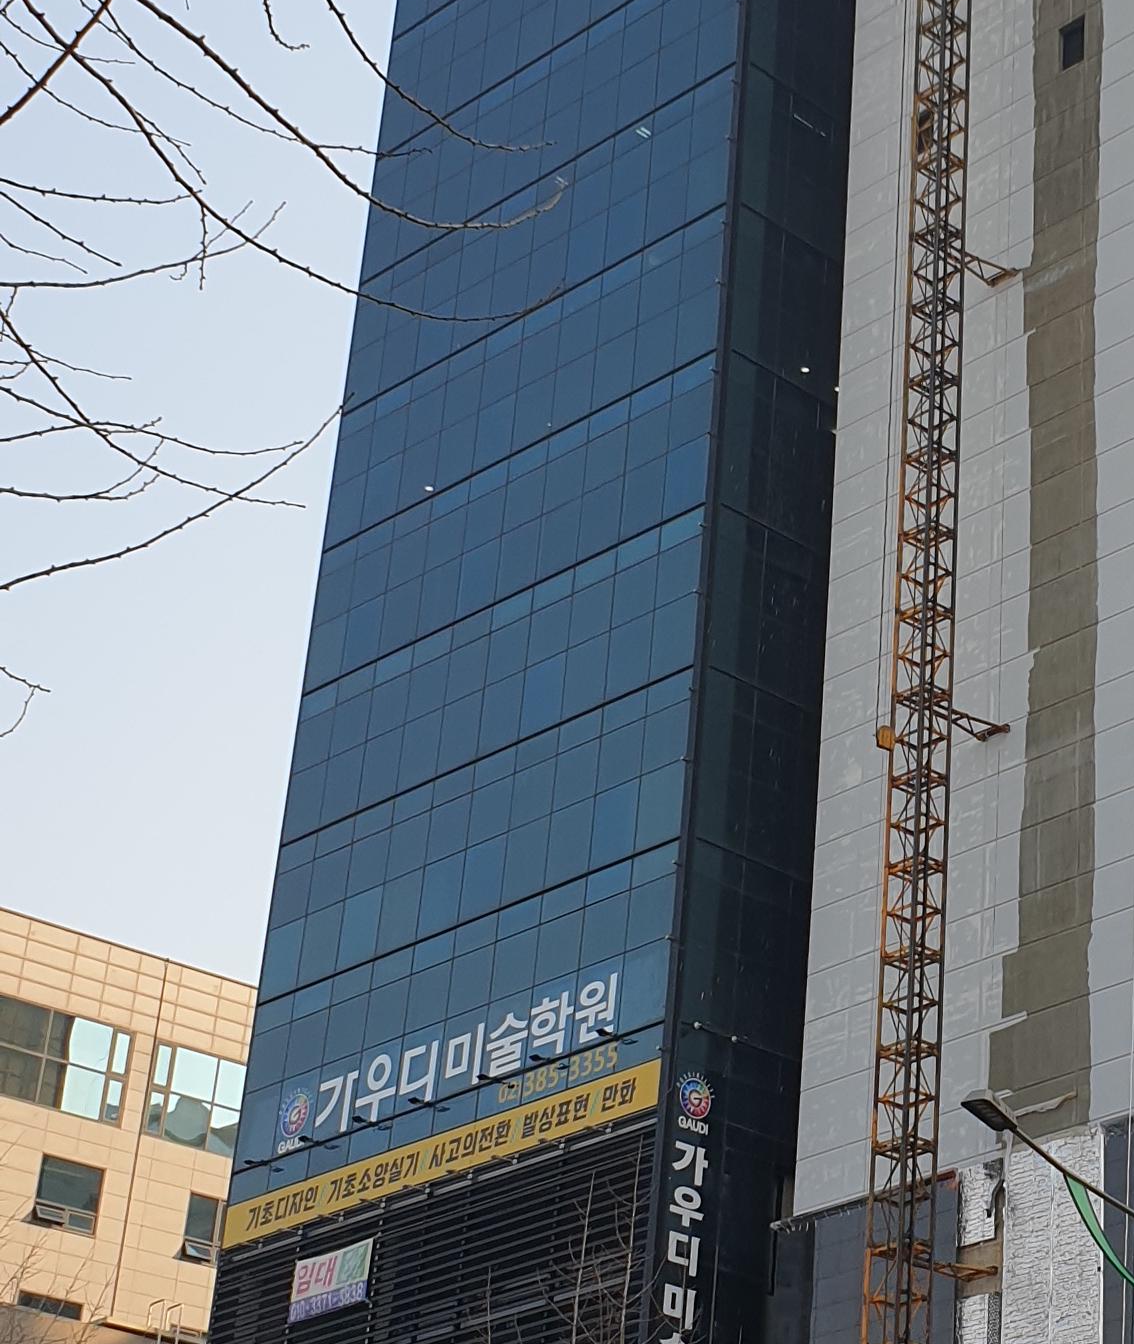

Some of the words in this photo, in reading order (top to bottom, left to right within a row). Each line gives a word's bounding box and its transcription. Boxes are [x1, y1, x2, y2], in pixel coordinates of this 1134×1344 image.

[315, 972, 618, 1133] 가우디미술학원
[246, 1184, 319, 1232] 기초디자인
[327, 1151, 421, 1205] 기초소양실기
[428, 1119, 512, 1171] 사고의전환
[520, 1092, 592, 1140] 발상표현
[600, 1077, 637, 1113] 만화
[678, 1115, 709, 1136] GAUDI
[296, 1256, 338, 1296] 임대
